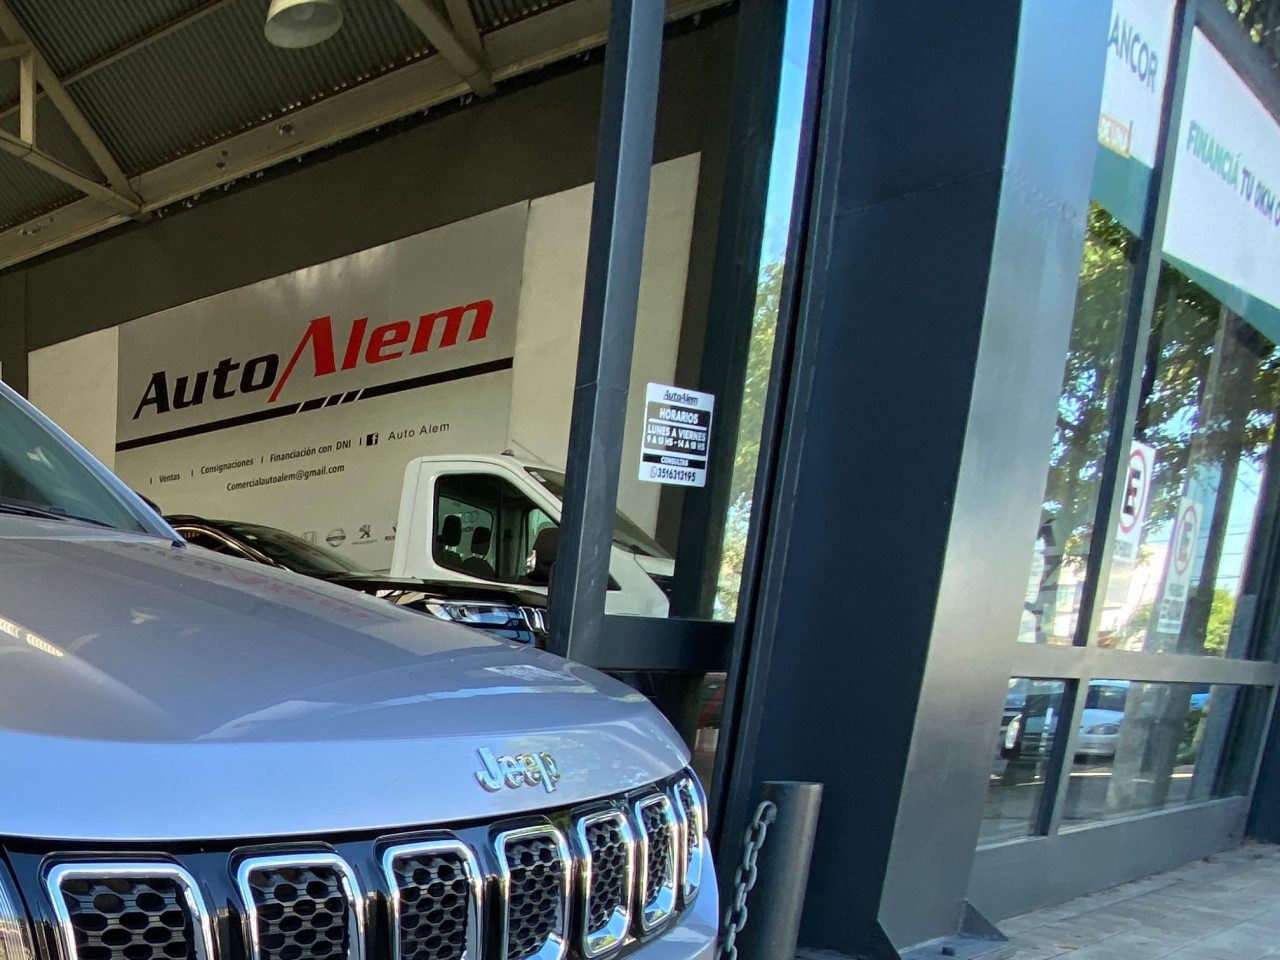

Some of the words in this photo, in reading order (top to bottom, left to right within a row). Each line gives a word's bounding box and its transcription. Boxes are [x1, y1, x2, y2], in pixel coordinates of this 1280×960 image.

[1240, 167, 1255, 200] TU
[659, 407, 699, 424] HORARIOS
[647, 424, 671, 437] LUNES
[671, 428, 677, 438] A
[678, 429, 707, 442] VIERNES
[664, 438, 674, 447] HS
[159, 473, 181, 484] Ventas
[200, 458, 254, 474] Consignaciones
[270, 446, 316, 462] Financiación
[318, 444, 333, 454] con
[336, 440, 352, 451] DNI
[388, 428, 415, 441] Auto
[419, 423, 450, 435] Alem
[226, 464, 345, 491] Comercialautoalem@gmail.com
[475, 747, 560, 793] Jeep
